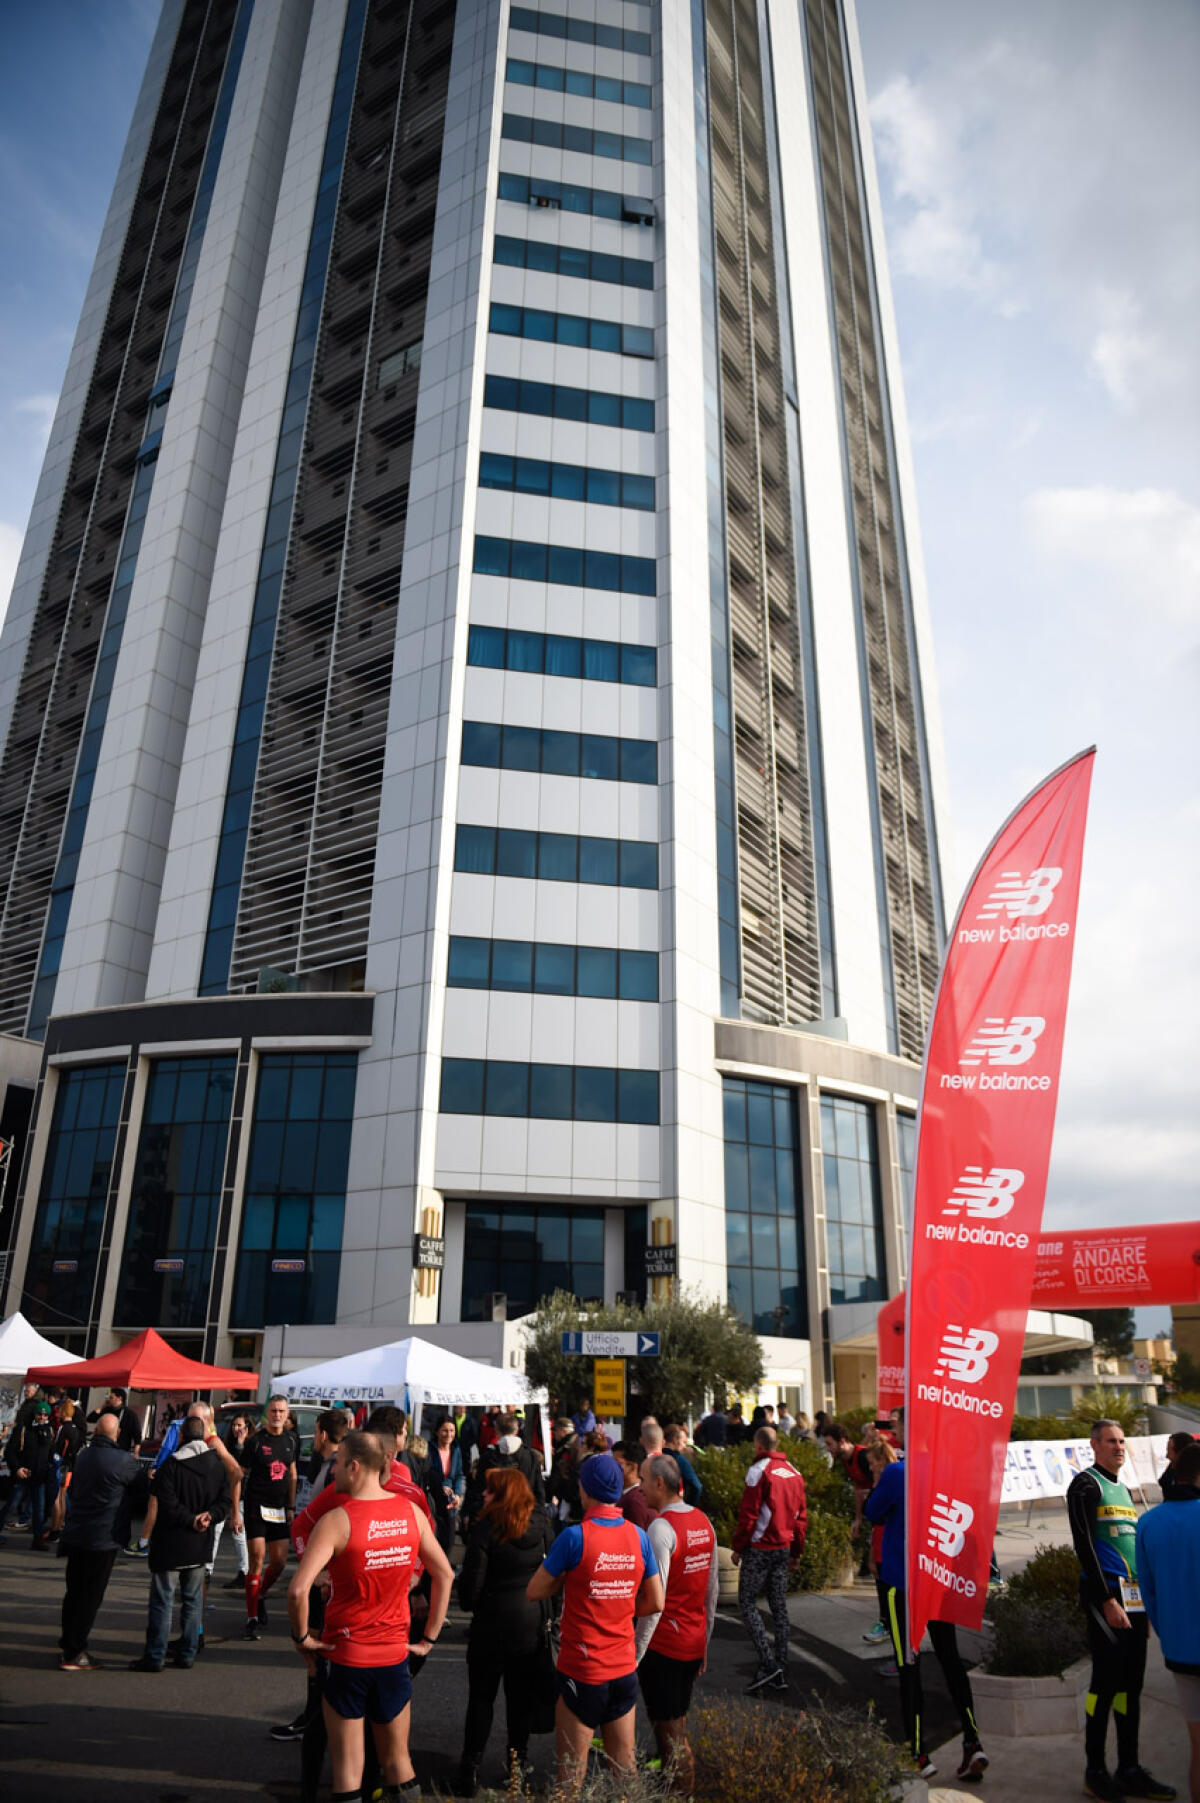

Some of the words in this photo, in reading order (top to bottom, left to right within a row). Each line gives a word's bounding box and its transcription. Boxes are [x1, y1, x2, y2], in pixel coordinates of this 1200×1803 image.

[958, 929, 996, 944] new
[999, 922, 1069, 942] balance
[940, 1073, 976, 1088] new
[979, 1071, 1051, 1090] balance
[926, 1223, 956, 1240] new
[958, 1223, 1029, 1249] balance
[1037, 1242, 1064, 1256] one
[1072, 1245, 1147, 1268] ANDARE
[1074, 1269, 1091, 1286] DI
[1093, 1265, 1149, 1285] CORSA
[586, 1333, 620, 1345] Ufficio
[586, 1344, 626, 1354] Vendite
[299, 1386, 338, 1400] REALE
[344, 1386, 385, 1400] MUTUA
[436, 1392, 476, 1405] REALE
[942, 1386, 1003, 1418] balance
[1003, 1473, 1043, 1493] UTUA
[369, 1519, 408, 1529] Atletica
[598, 1552, 635, 1562] Atletica
[918, 1553, 932, 1575] nw
[932, 1556, 977, 1598] balance
